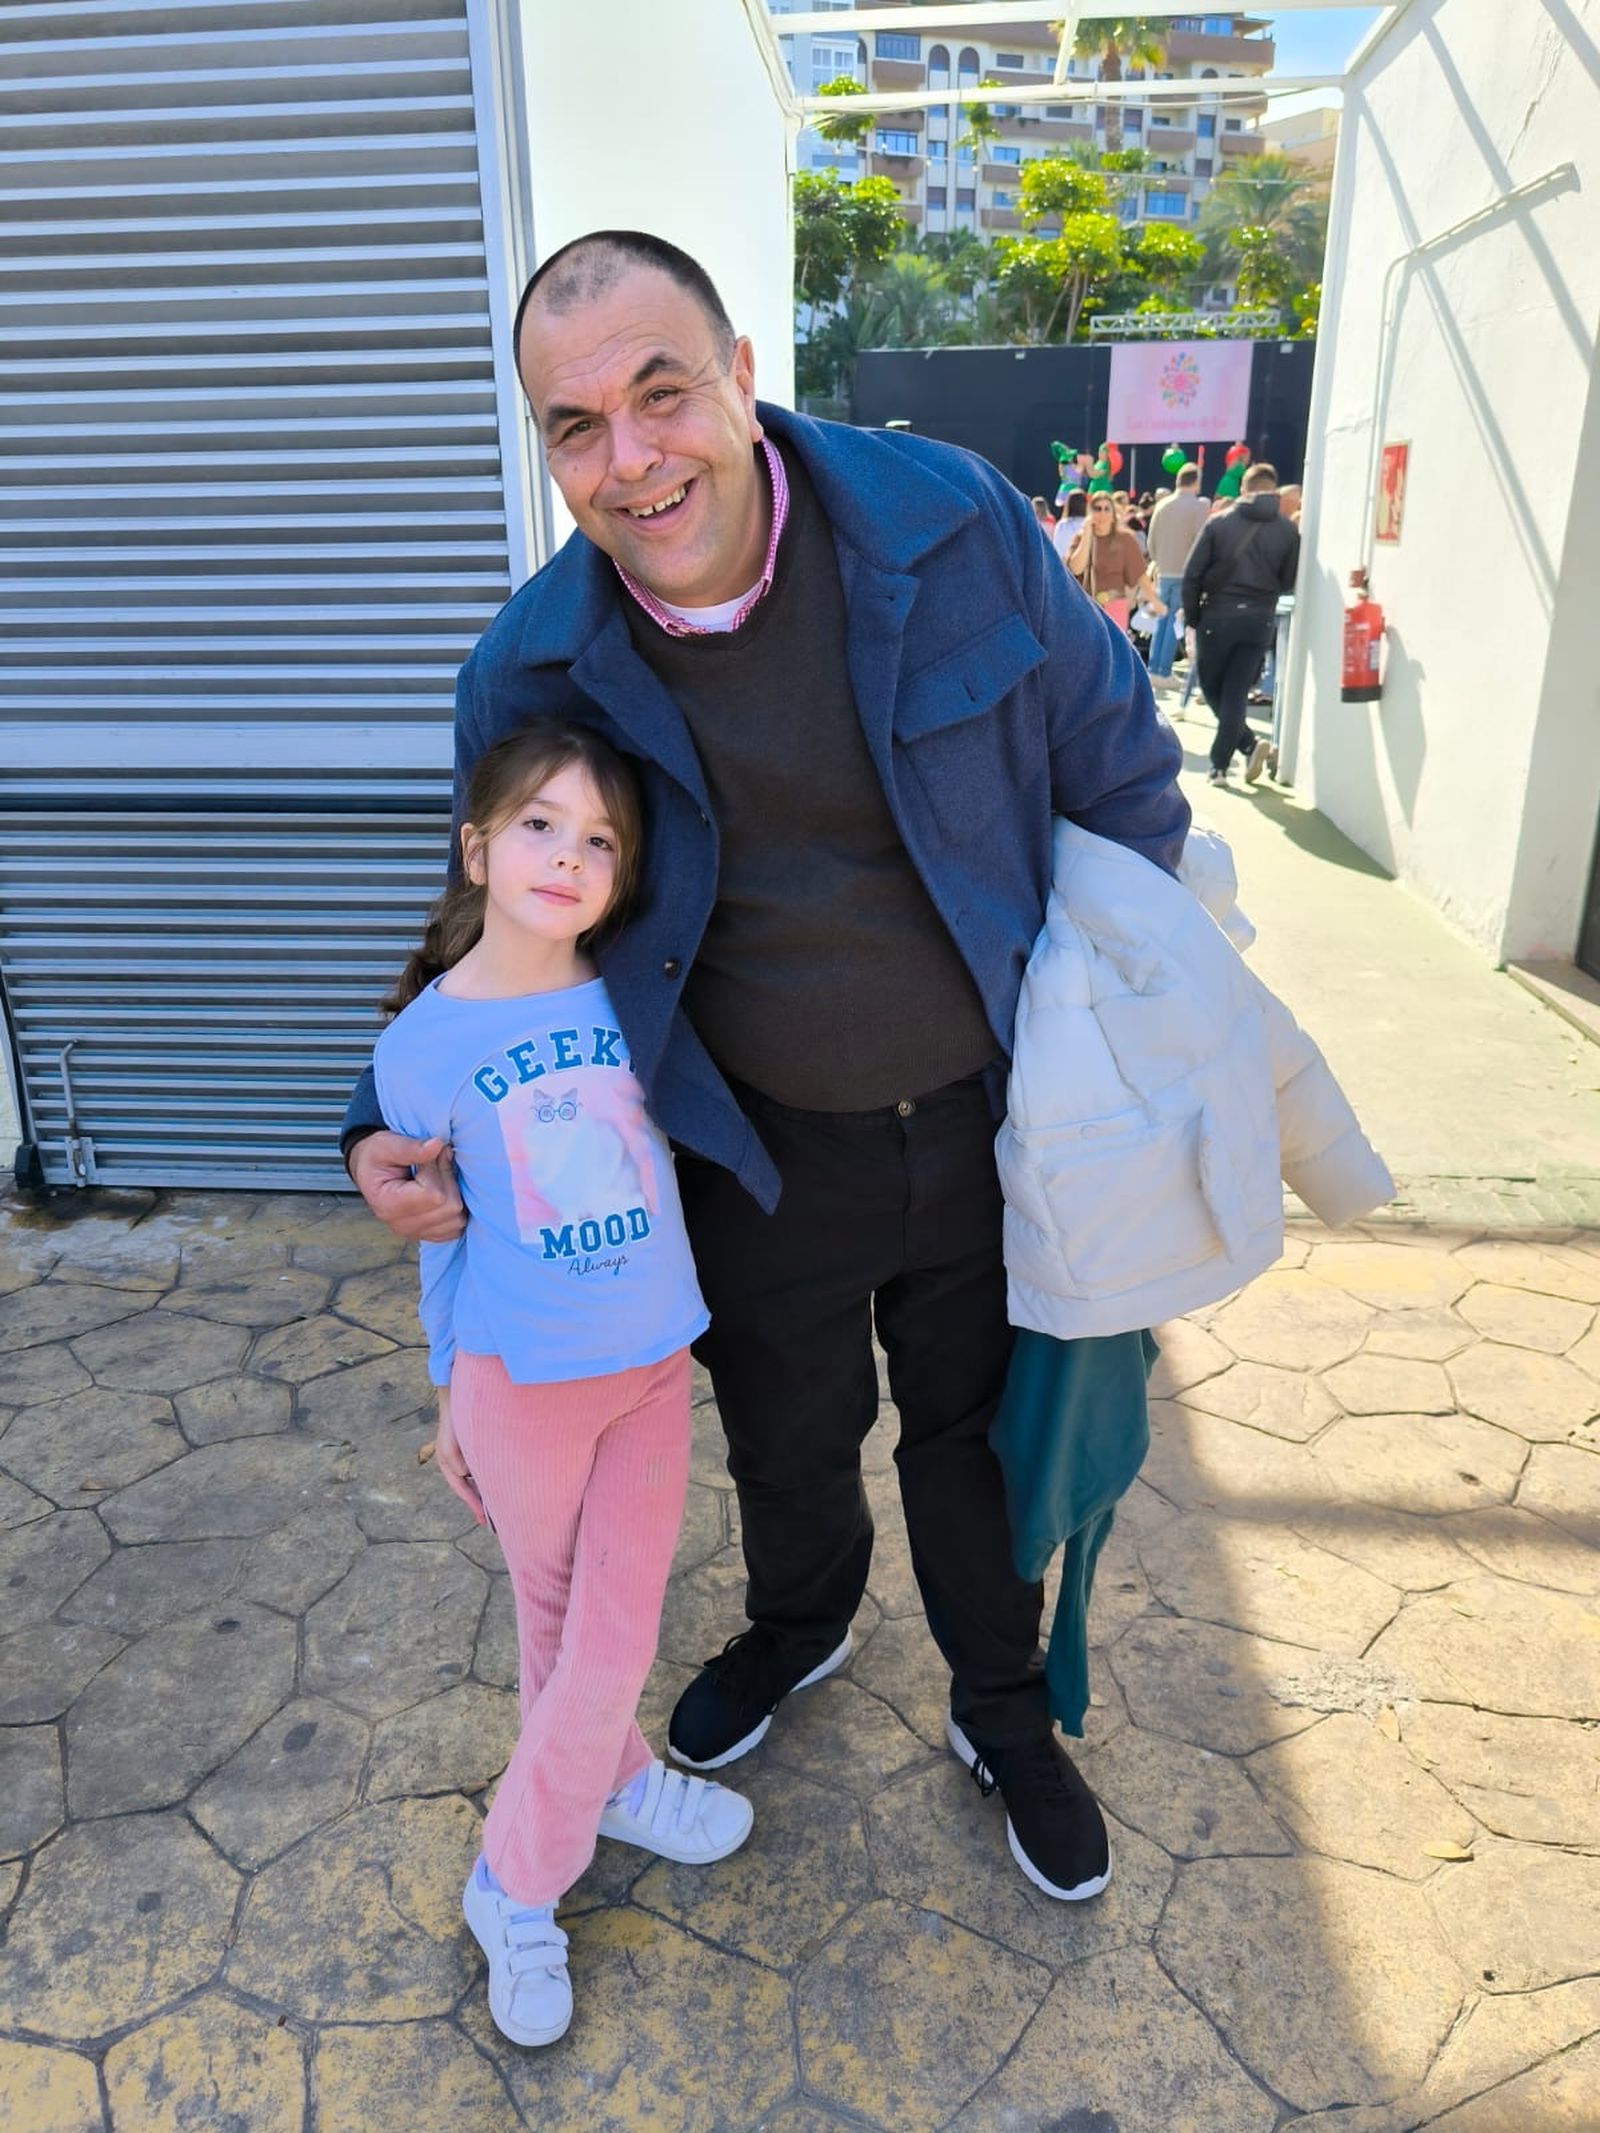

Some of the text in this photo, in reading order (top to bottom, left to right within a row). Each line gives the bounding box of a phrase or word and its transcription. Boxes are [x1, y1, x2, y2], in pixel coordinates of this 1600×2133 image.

[474, 1027, 635, 1104] GEEK
[539, 1207, 651, 1260] MOOD
[567, 1254, 630, 1276] Always
